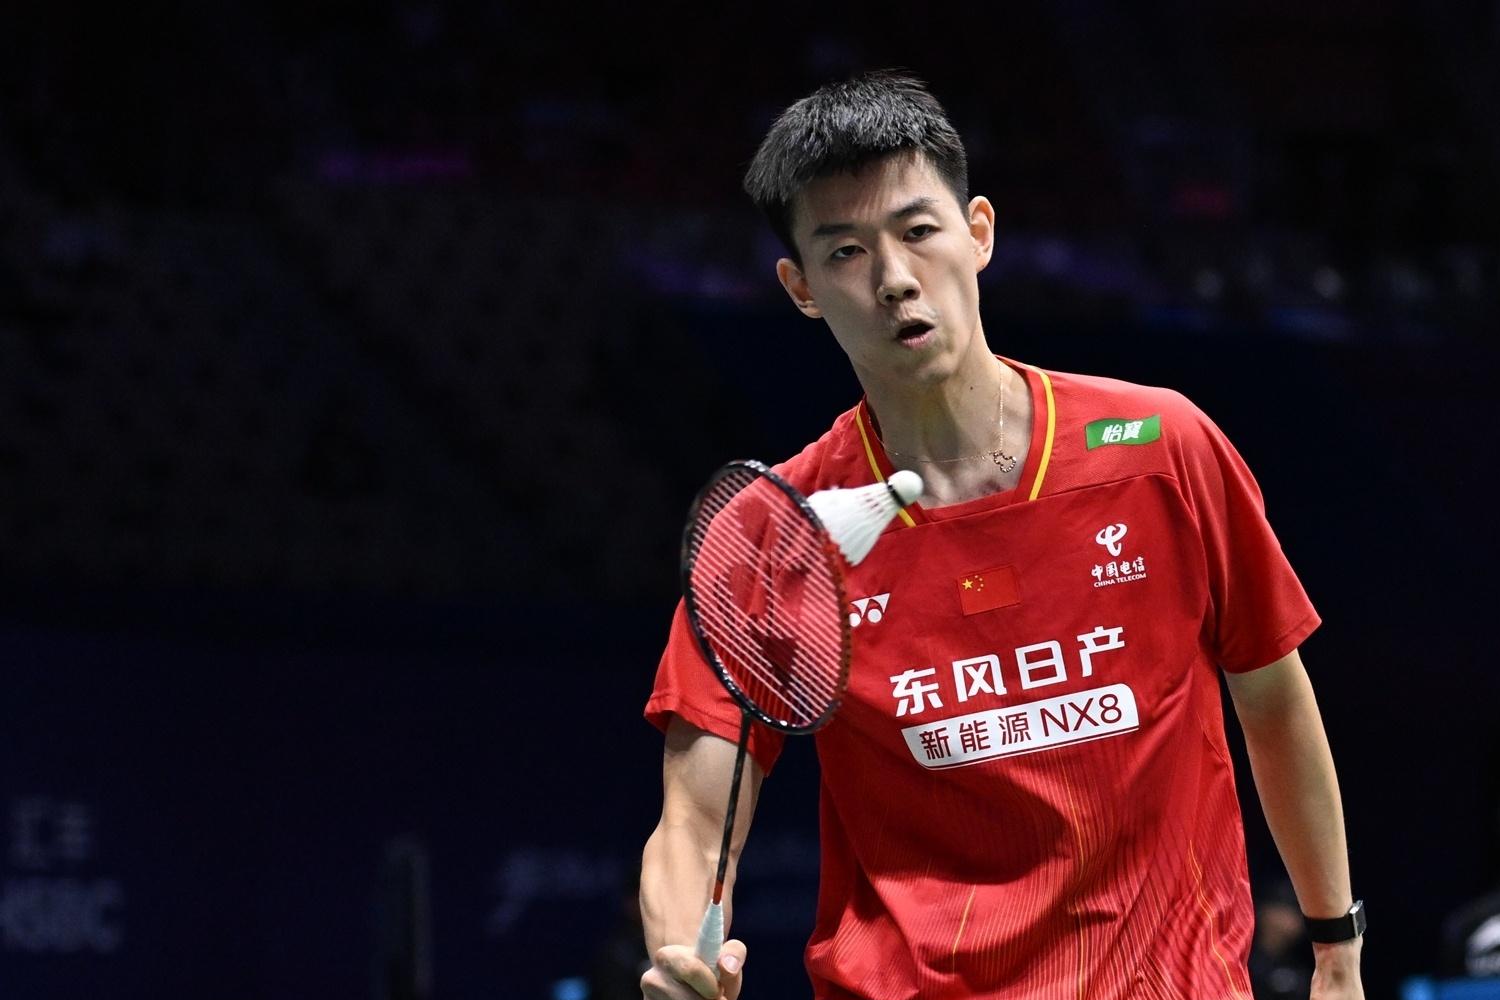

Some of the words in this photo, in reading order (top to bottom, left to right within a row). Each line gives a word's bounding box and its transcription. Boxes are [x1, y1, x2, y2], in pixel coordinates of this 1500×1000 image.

[1091, 556, 1145, 582] 中国电信
[1093, 579, 1116, 588] CHINA
[1116, 572, 1147, 583] TELECOM
[889, 626, 1125, 717] 东风日产
